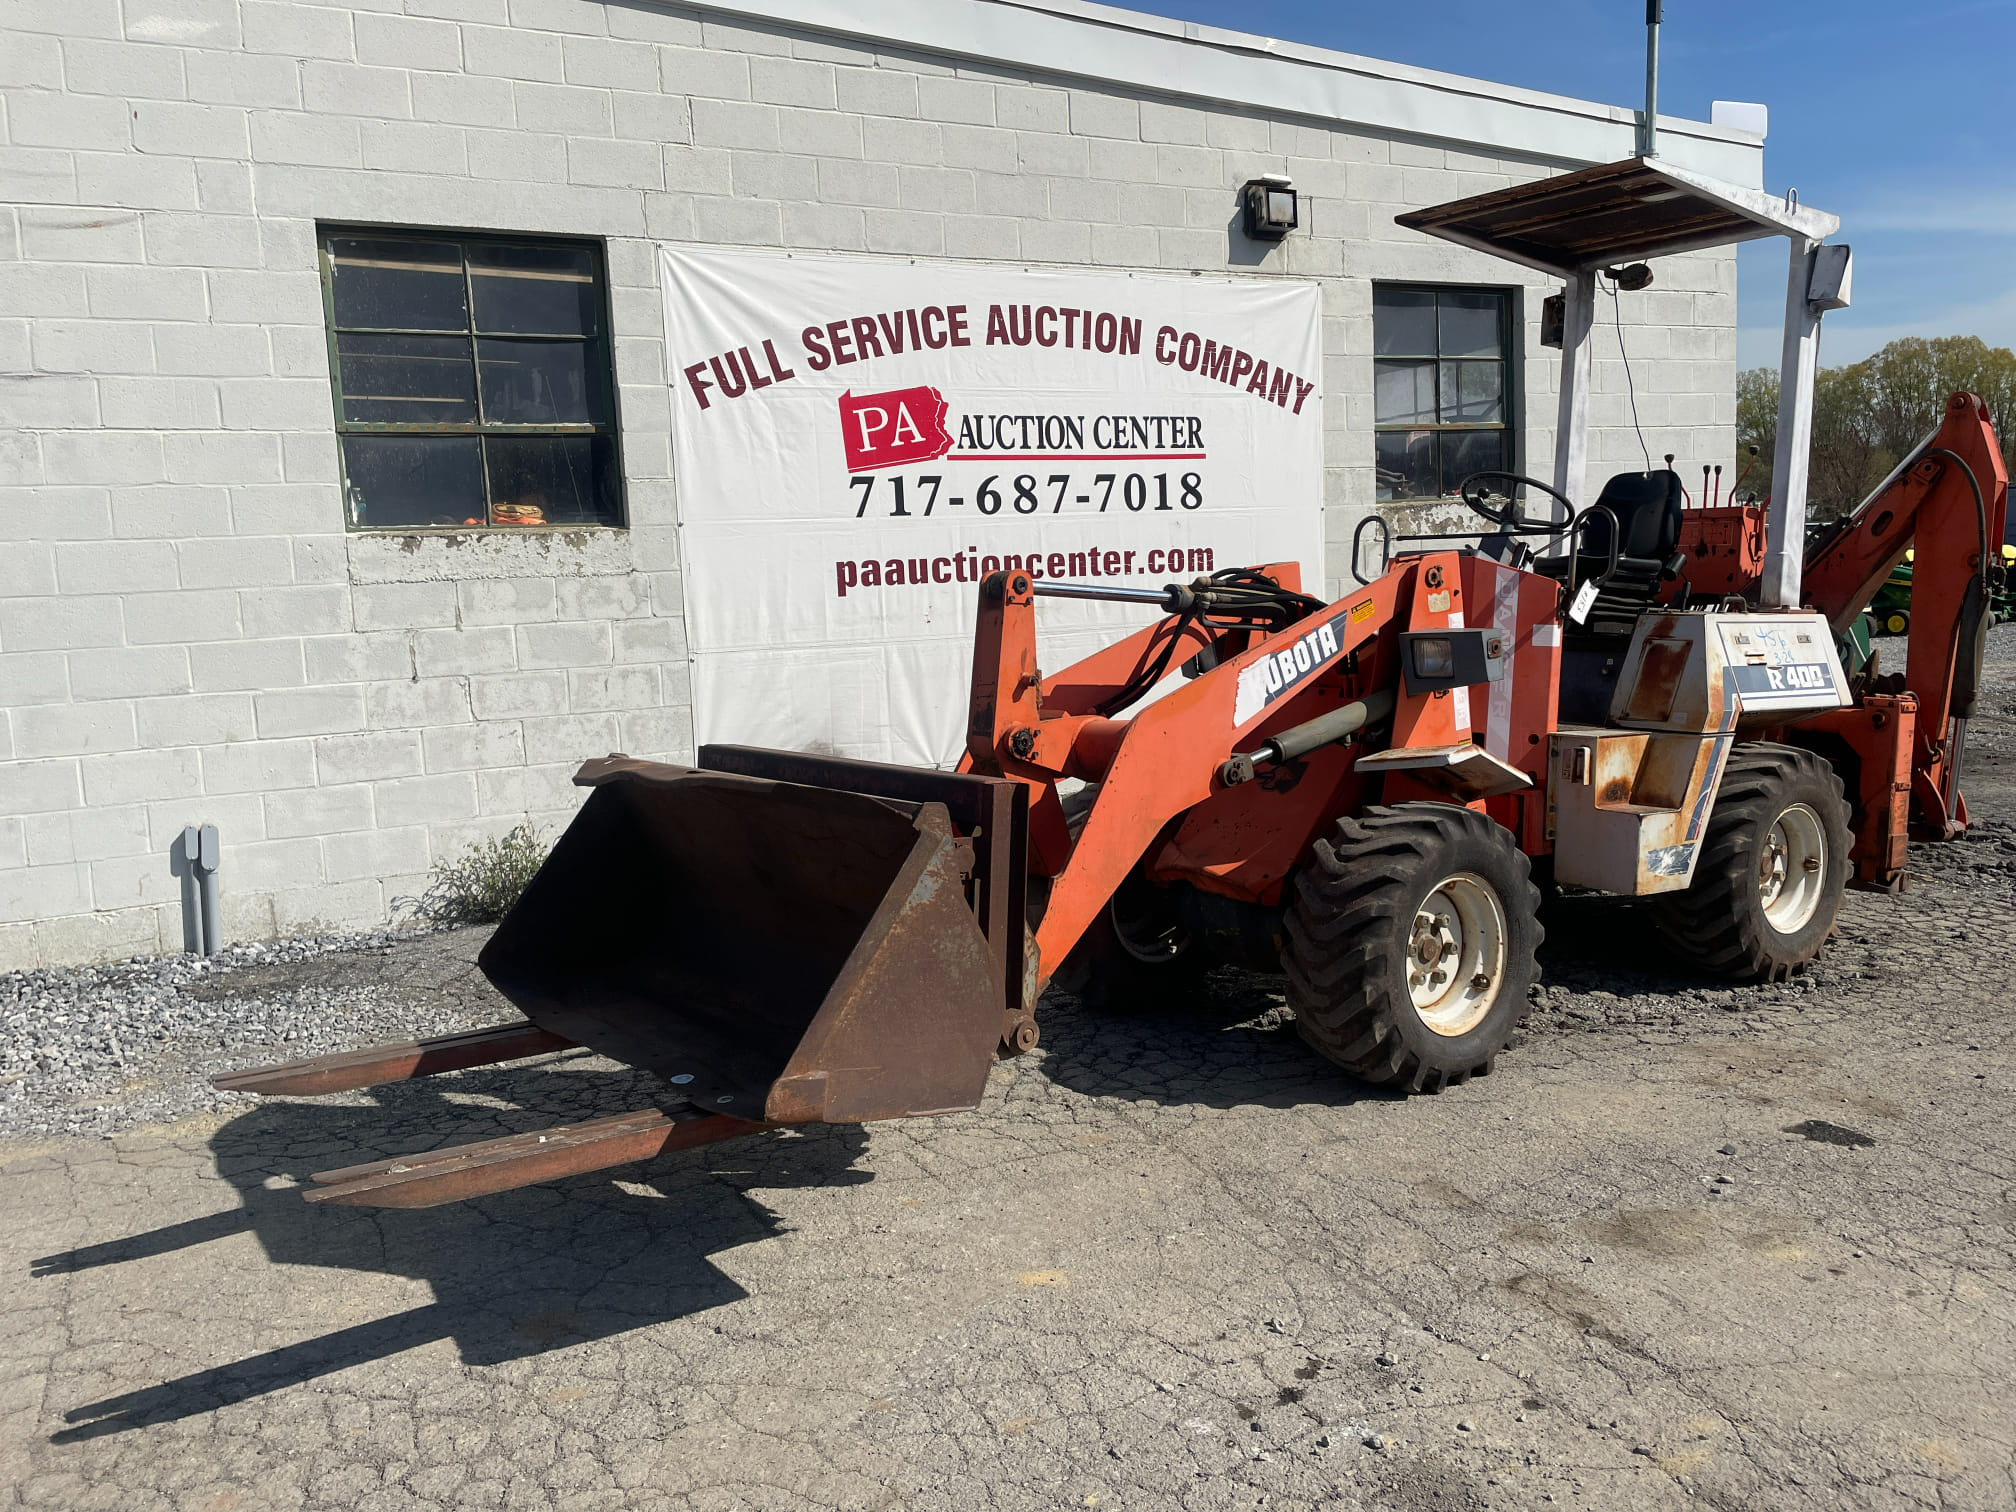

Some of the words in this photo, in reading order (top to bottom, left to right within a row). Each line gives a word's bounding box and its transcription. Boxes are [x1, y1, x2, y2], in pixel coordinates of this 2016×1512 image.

[684, 339, 796, 410] FULL
[802, 305, 971, 371] SERVICE
[986, 304, 1142, 355] AUCTION
[1156, 325, 1315, 416] COMPANY
[853, 401, 927, 453] PA
[957, 414, 1085, 450] AUCTION
[1093, 415, 1205, 449] CENTER
[849, 472, 1204, 518] 717-687-7018
[836, 546, 1214, 597] paauctioncenter.com
